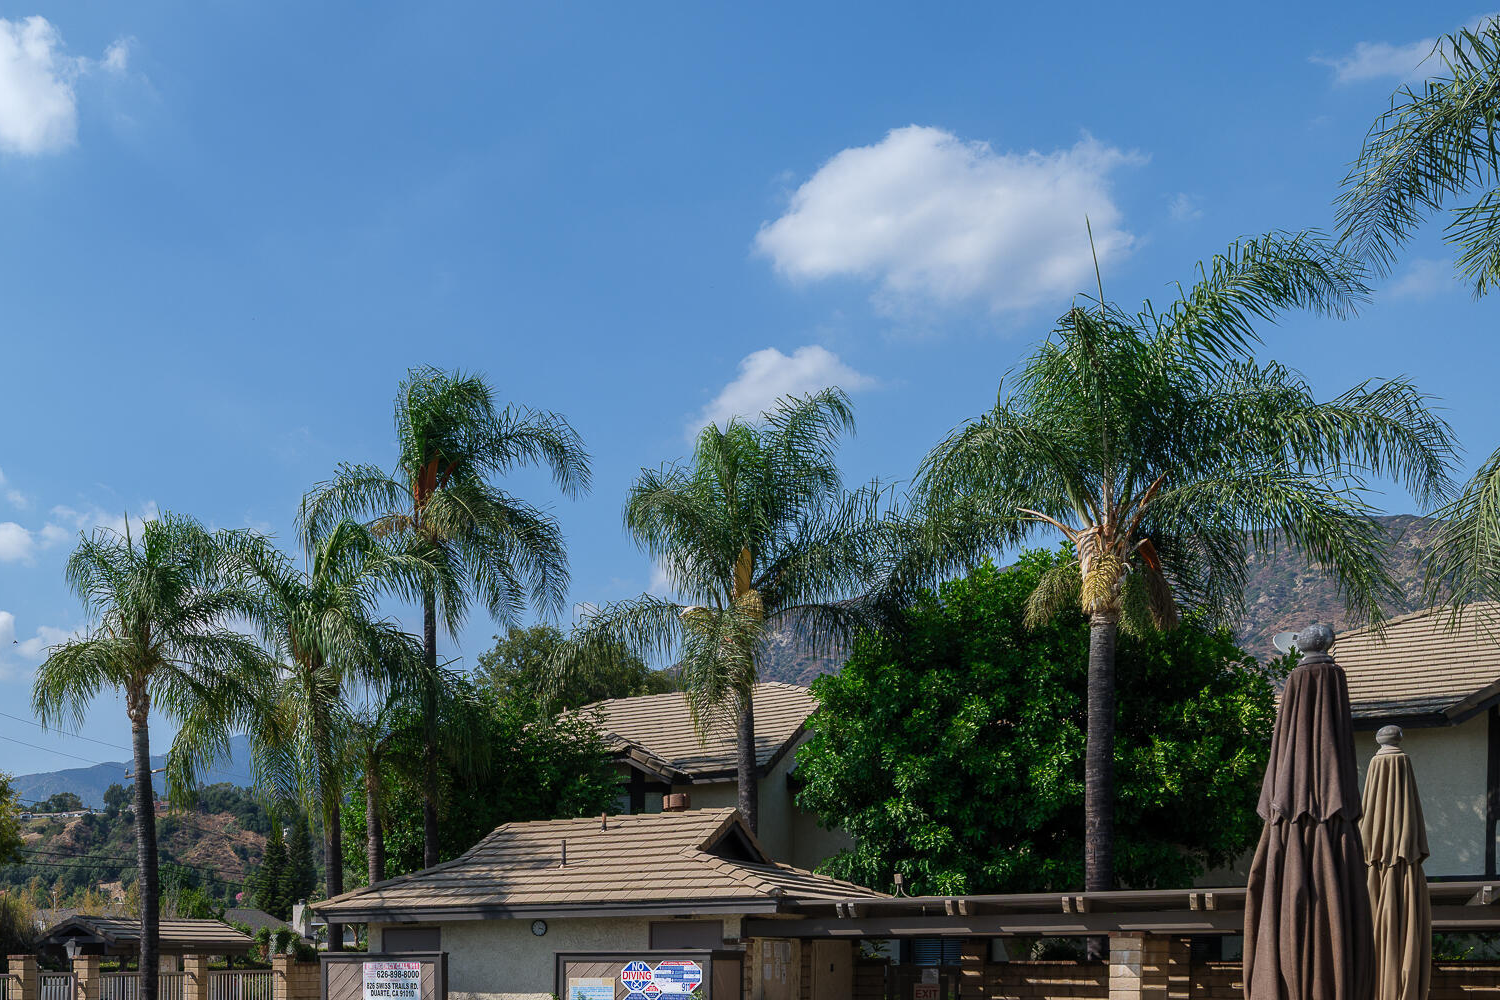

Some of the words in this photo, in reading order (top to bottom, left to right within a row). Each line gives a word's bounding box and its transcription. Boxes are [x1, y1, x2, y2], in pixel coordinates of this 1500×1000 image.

[631, 961, 644, 971] NO
[376, 970, 420, 978] 626-898-8000
[622, 971, 652, 980] DIVING
[681, 983, 690, 992] 911
[915, 989, 940, 999] EXIT
